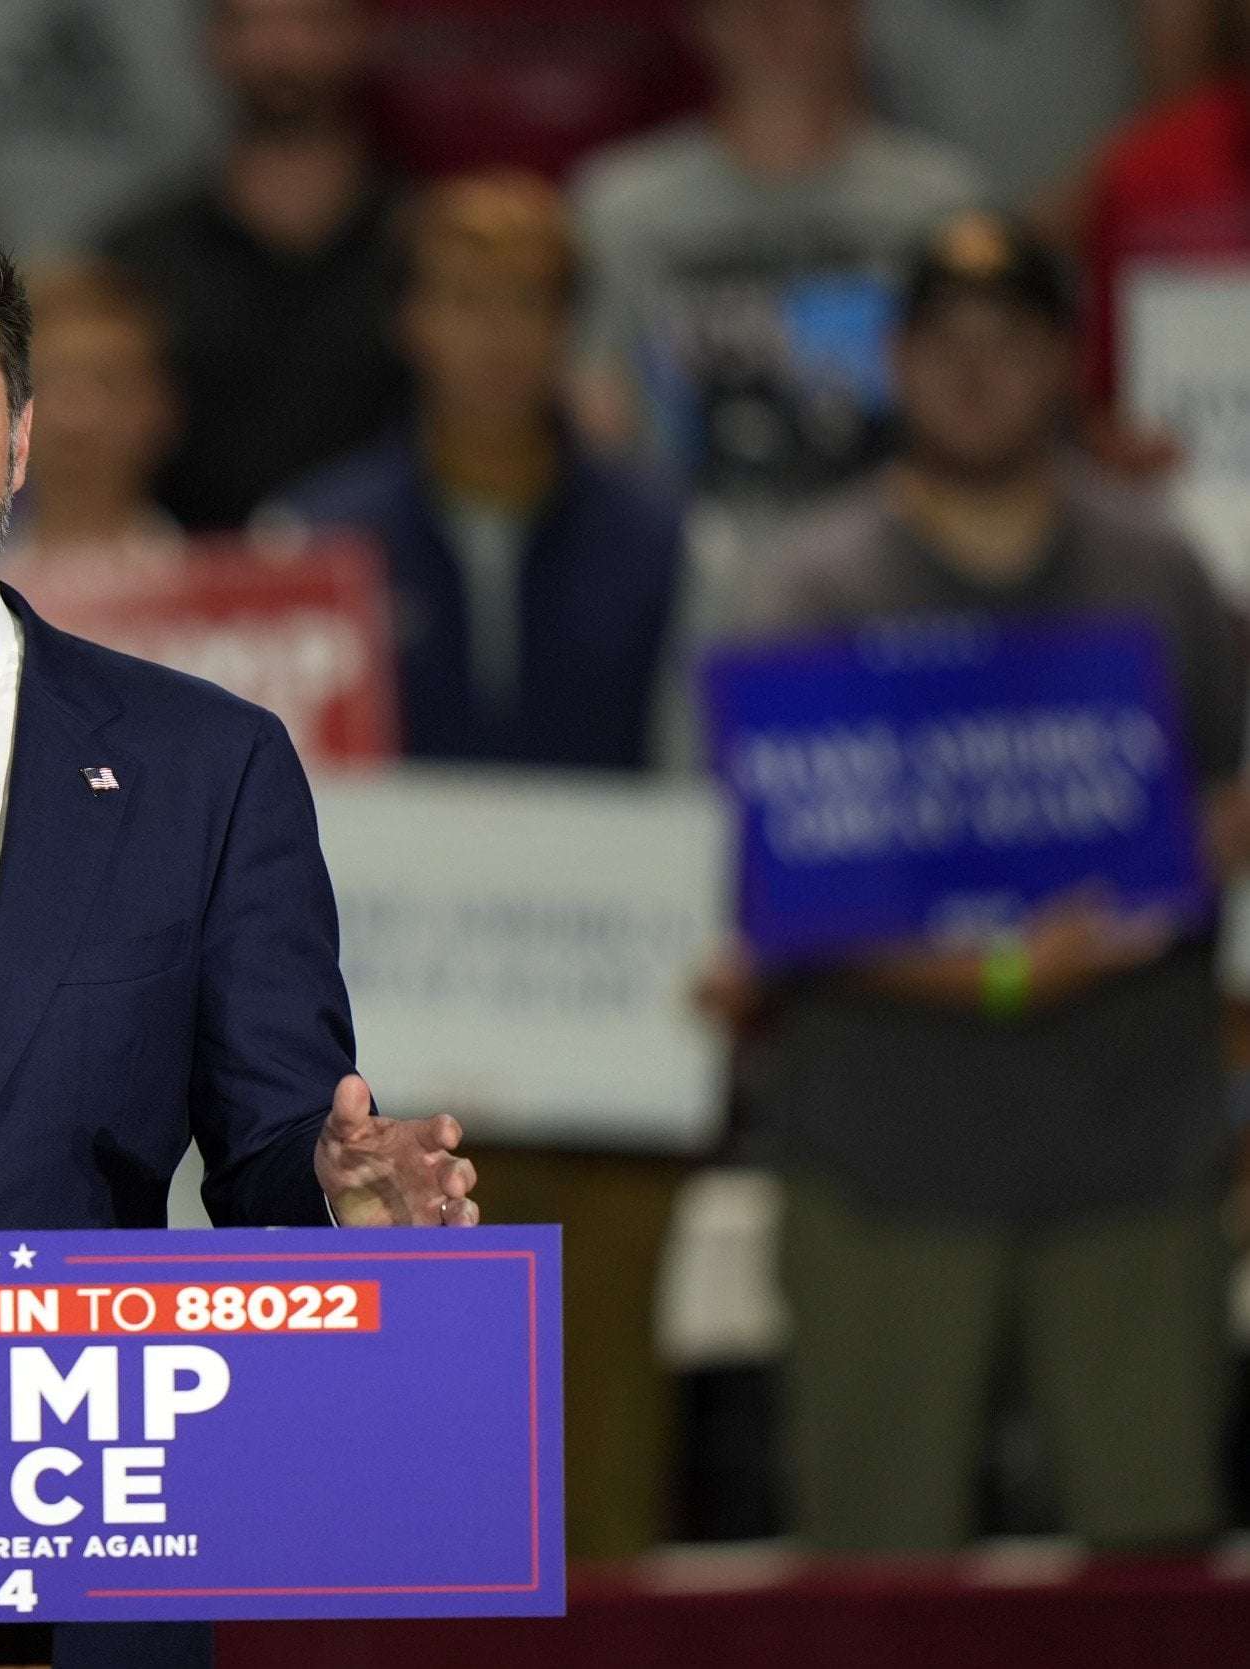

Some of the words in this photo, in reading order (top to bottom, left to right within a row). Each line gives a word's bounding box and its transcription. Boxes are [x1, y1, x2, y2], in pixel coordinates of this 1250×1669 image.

[77, 1287, 157, 1333] TO
[174, 1284, 359, 1332] 88022
[82, 1533, 199, 1559] AGAIN!
